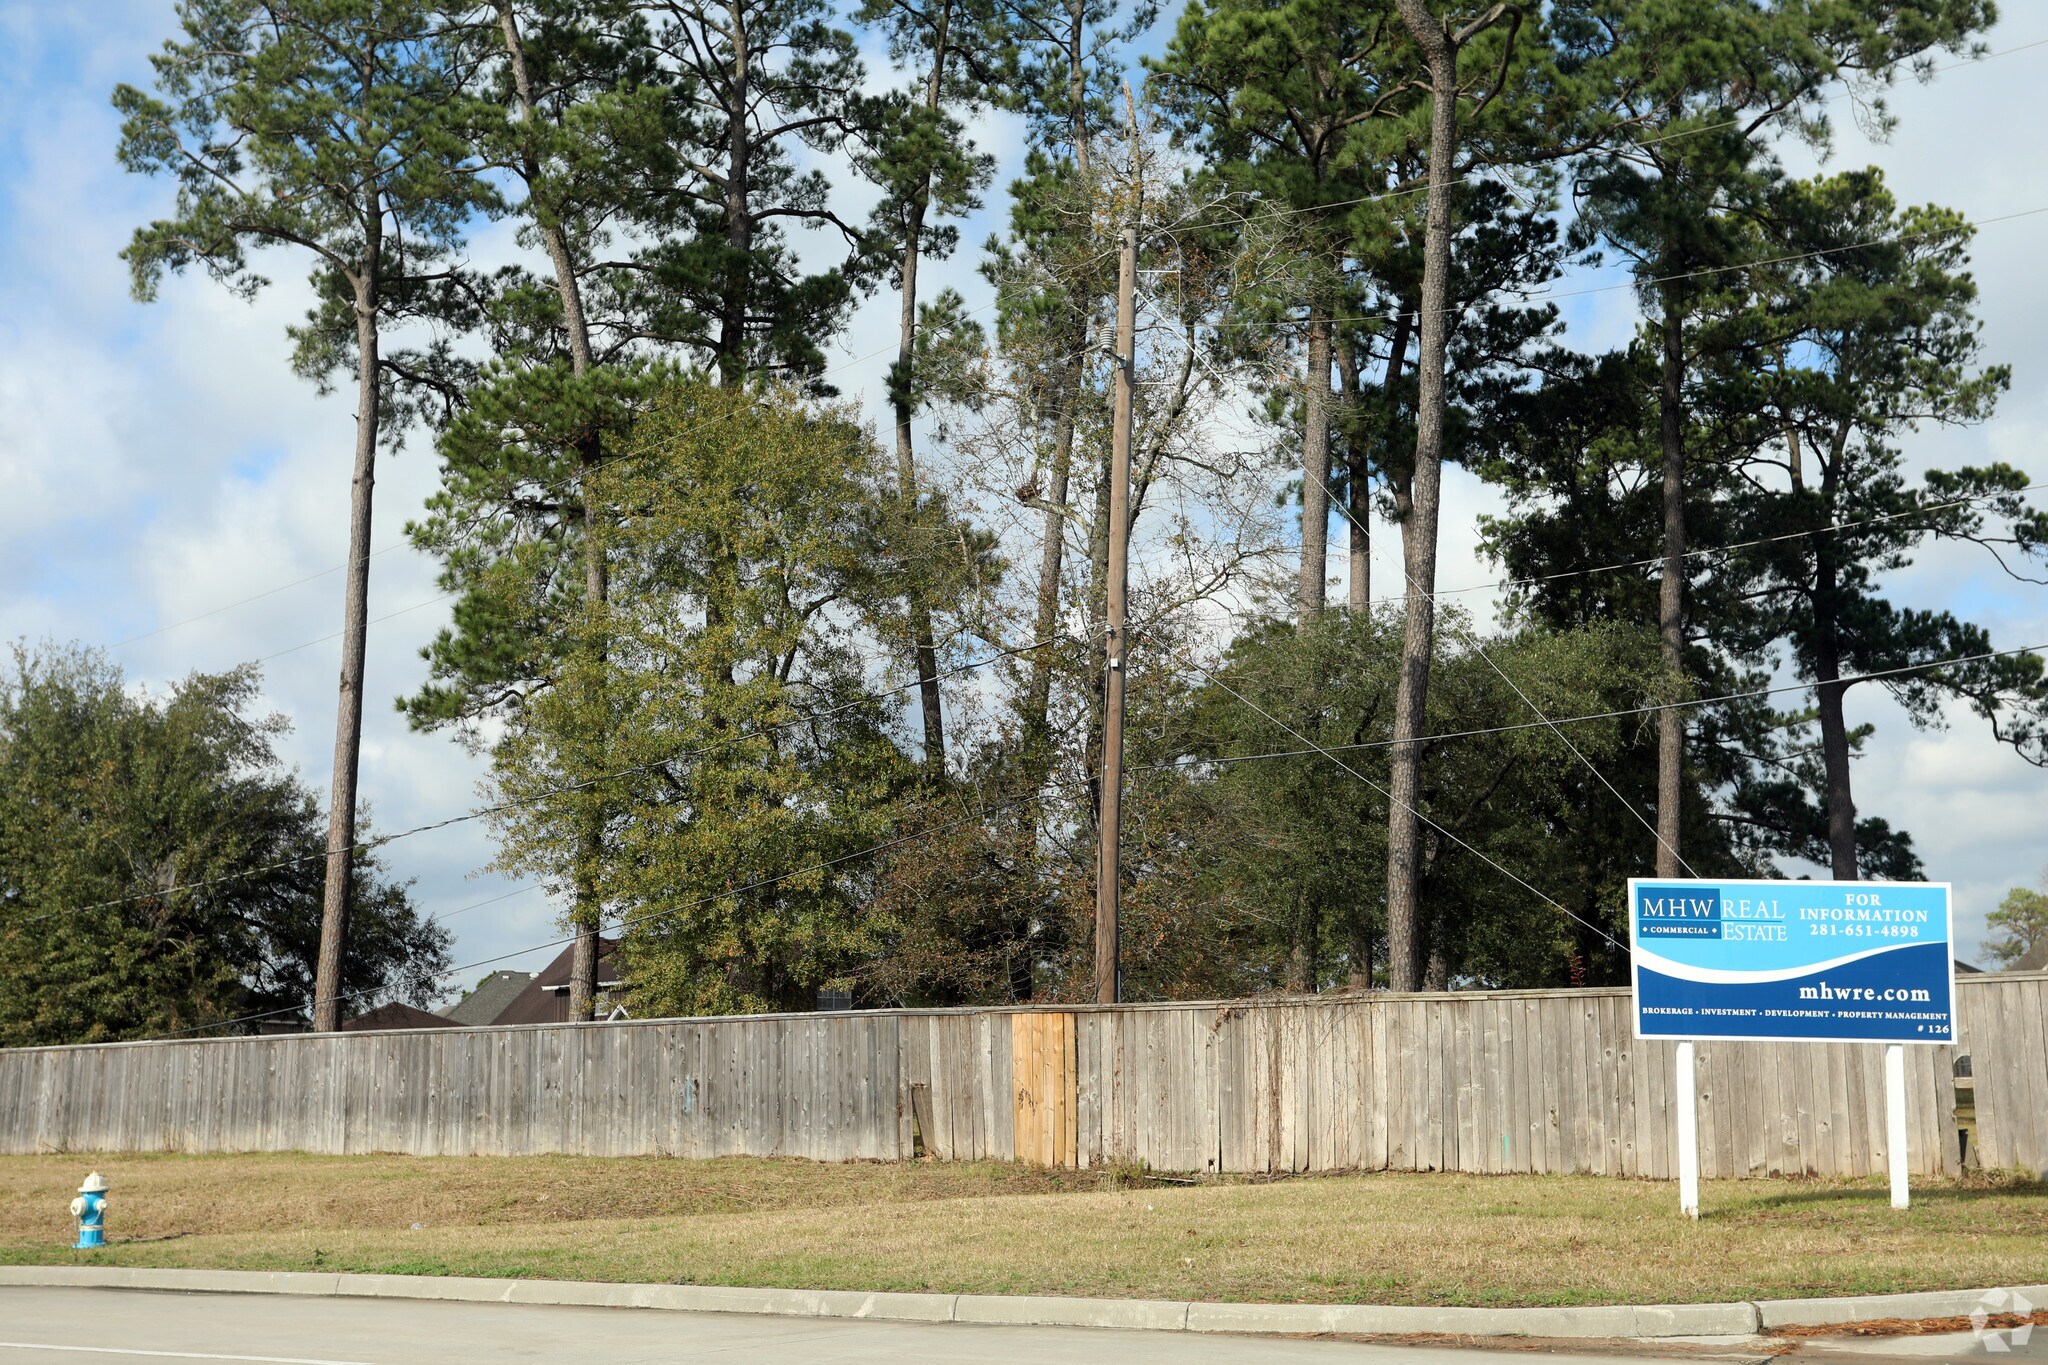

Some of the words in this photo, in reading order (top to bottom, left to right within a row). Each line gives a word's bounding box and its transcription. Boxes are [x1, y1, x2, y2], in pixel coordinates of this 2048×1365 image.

[1845, 893, 1882, 906] FOR
[1643, 898, 1714, 918] MHW
[1722, 899, 1785, 919] REAL
[1799, 908, 1928, 923] INFORMATION
[1650, 926, 1709, 934] COMMERCIAL
[1722, 921, 1788, 941] ESTATE
[1810, 923, 1919, 938] 281-651-4898
[1799, 981, 1931, 1002] mhwre.com
[1642, 1007, 1694, 1015] BROKERAGE
[1701, 1008, 1757, 1016] INVESTMENT
[1764, 1009, 1830, 1018] DEVELOPMENT
[1837, 1011, 1884, 1019] PROPERTY
[1885, 1012, 1948, 1020] MANAGEMENT
[1928, 1025, 1950, 1033] 126
